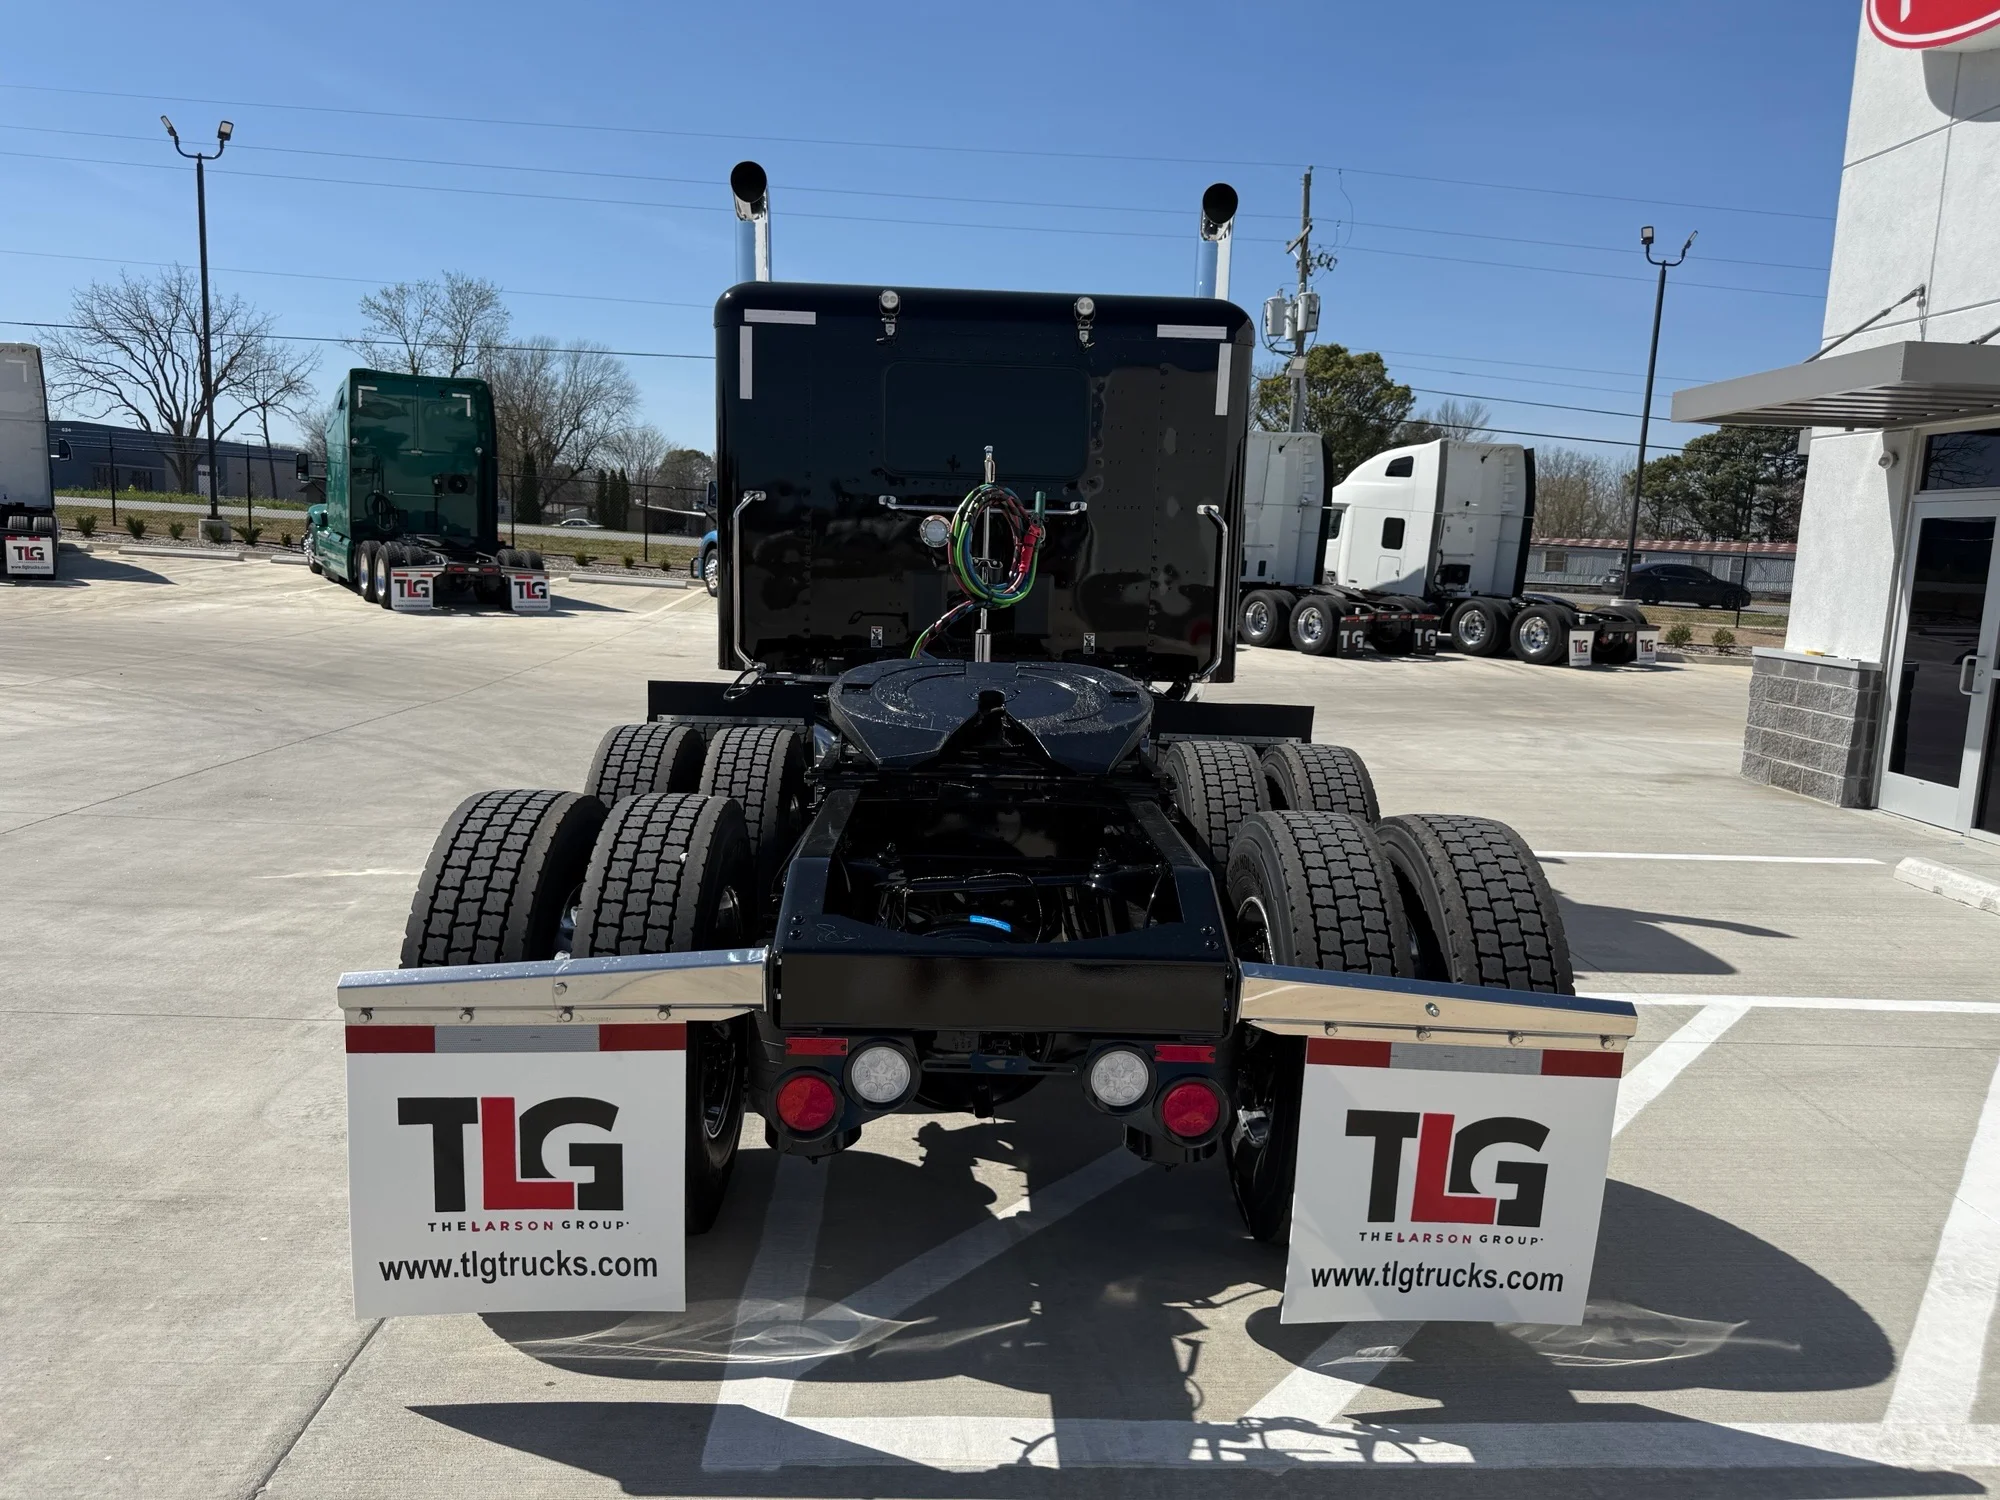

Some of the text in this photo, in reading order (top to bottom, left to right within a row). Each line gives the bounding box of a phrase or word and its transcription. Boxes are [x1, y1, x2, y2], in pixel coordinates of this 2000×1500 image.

[13, 545, 45, 561] TLG
[394, 579, 429, 598] TLG
[514, 581, 547, 599] TLG
[1573, 640, 1588, 653] TLG
[1640, 640, 1654, 652] TLG
[398, 1097, 624, 1213] TLG
[1345, 1109, 1551, 1228] TLG
[561, 1220, 625, 1231] GROUP
[1479, 1234, 1539, 1246] GROUP
[379, 1250, 658, 1285] www.tlgtrucks.com
[1311, 1261, 1564, 1294] www.tlgtrucks.com
